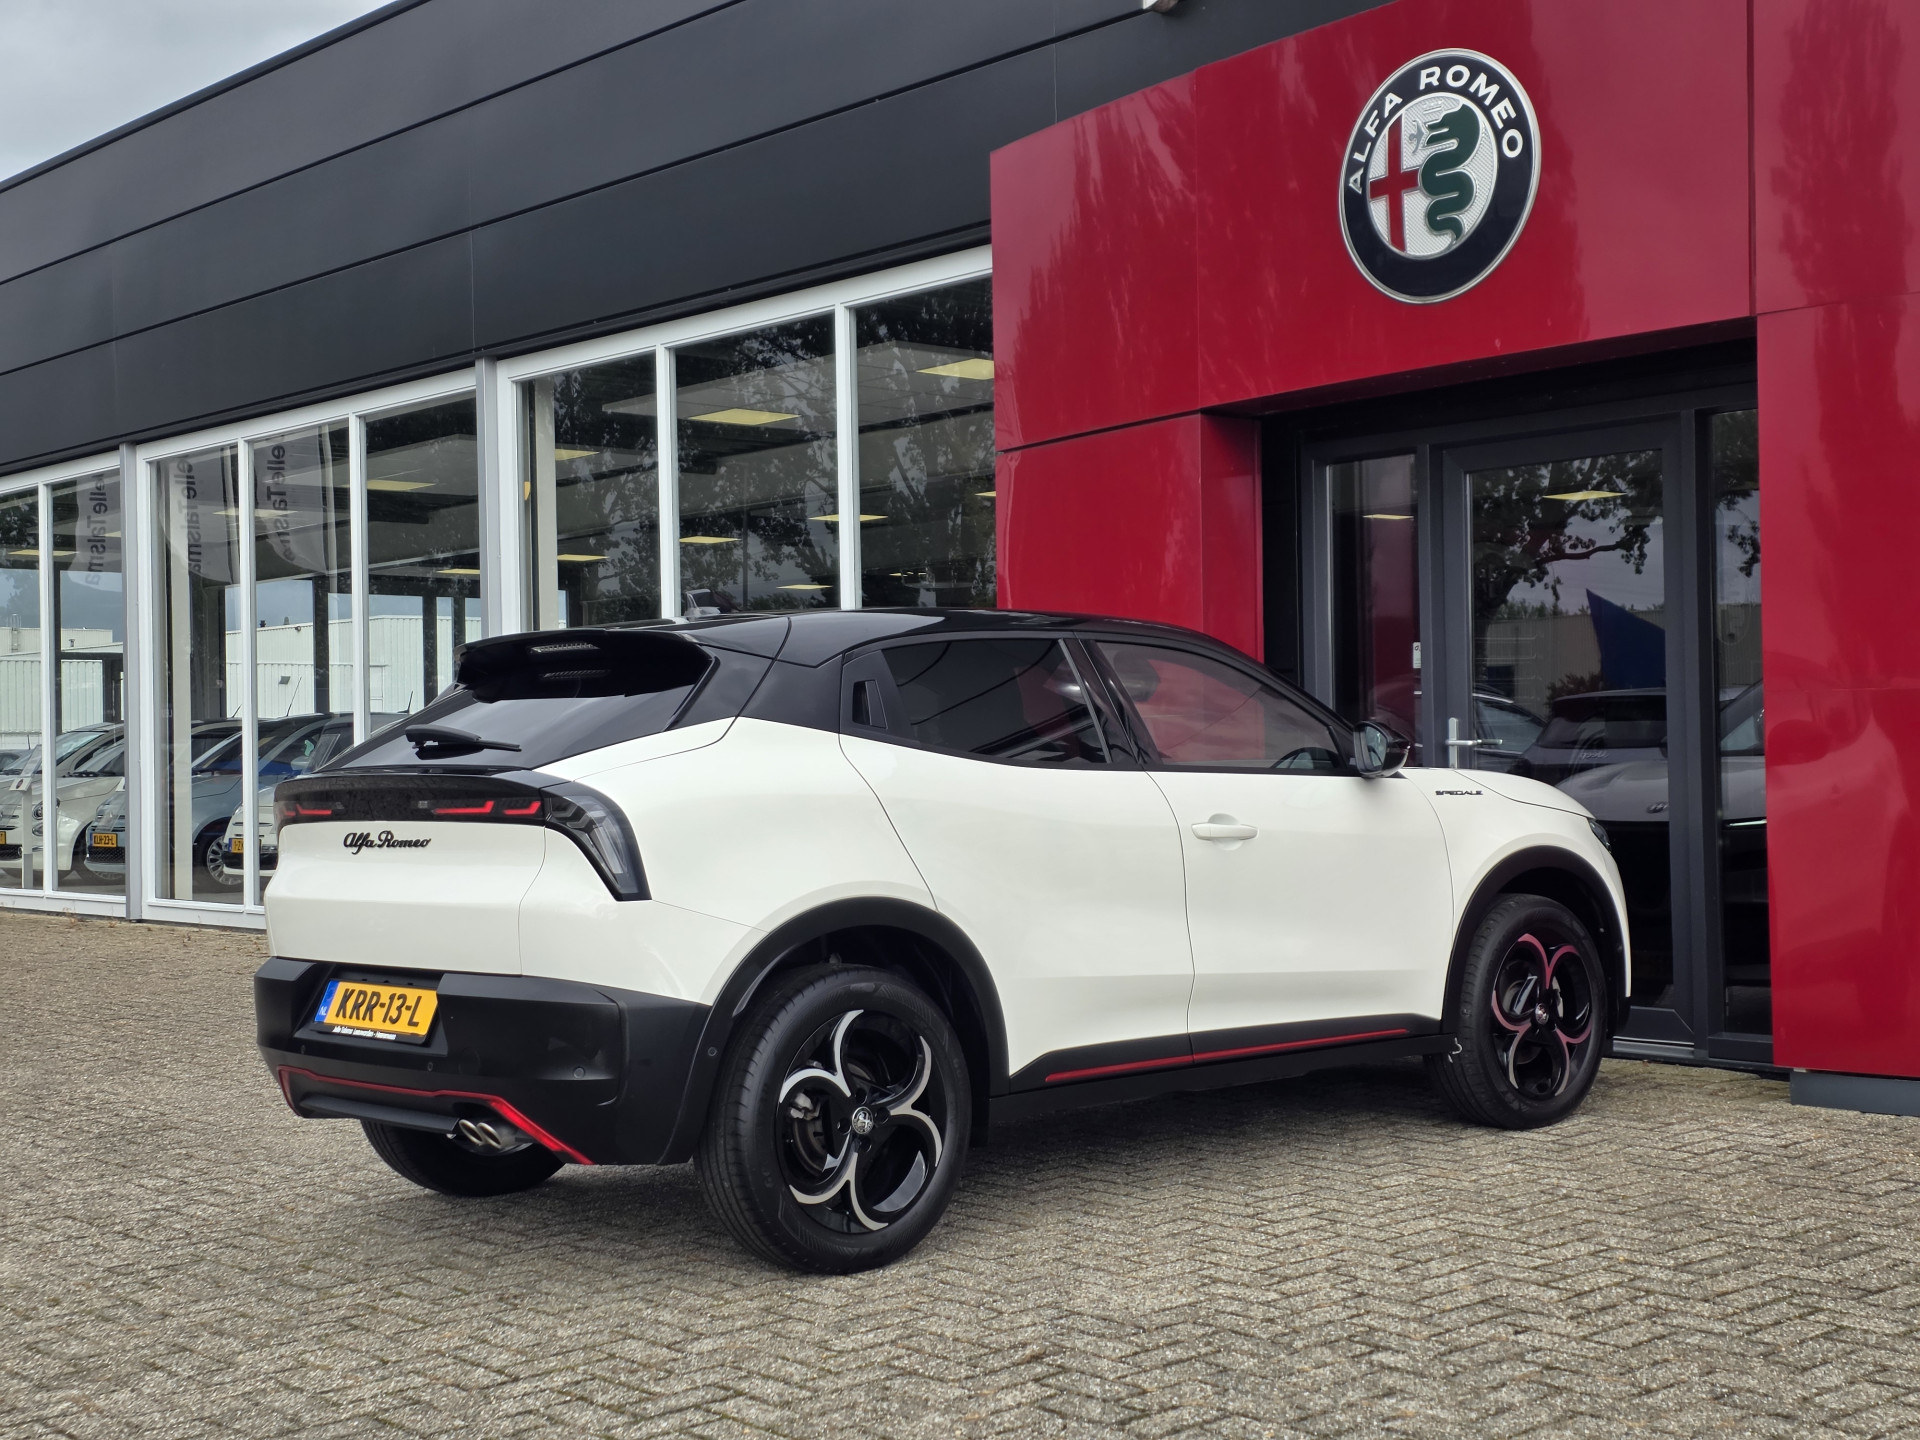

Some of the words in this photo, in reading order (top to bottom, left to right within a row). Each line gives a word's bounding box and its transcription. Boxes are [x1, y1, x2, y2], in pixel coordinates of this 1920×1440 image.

[1349, 92, 1402, 193] ALFA
[1419, 65, 1523, 158] ROMEO
[343, 832, 376, 855] Alfa
[377, 830, 431, 848] Romeo
[335, 988, 423, 1028] KRR-13-L
